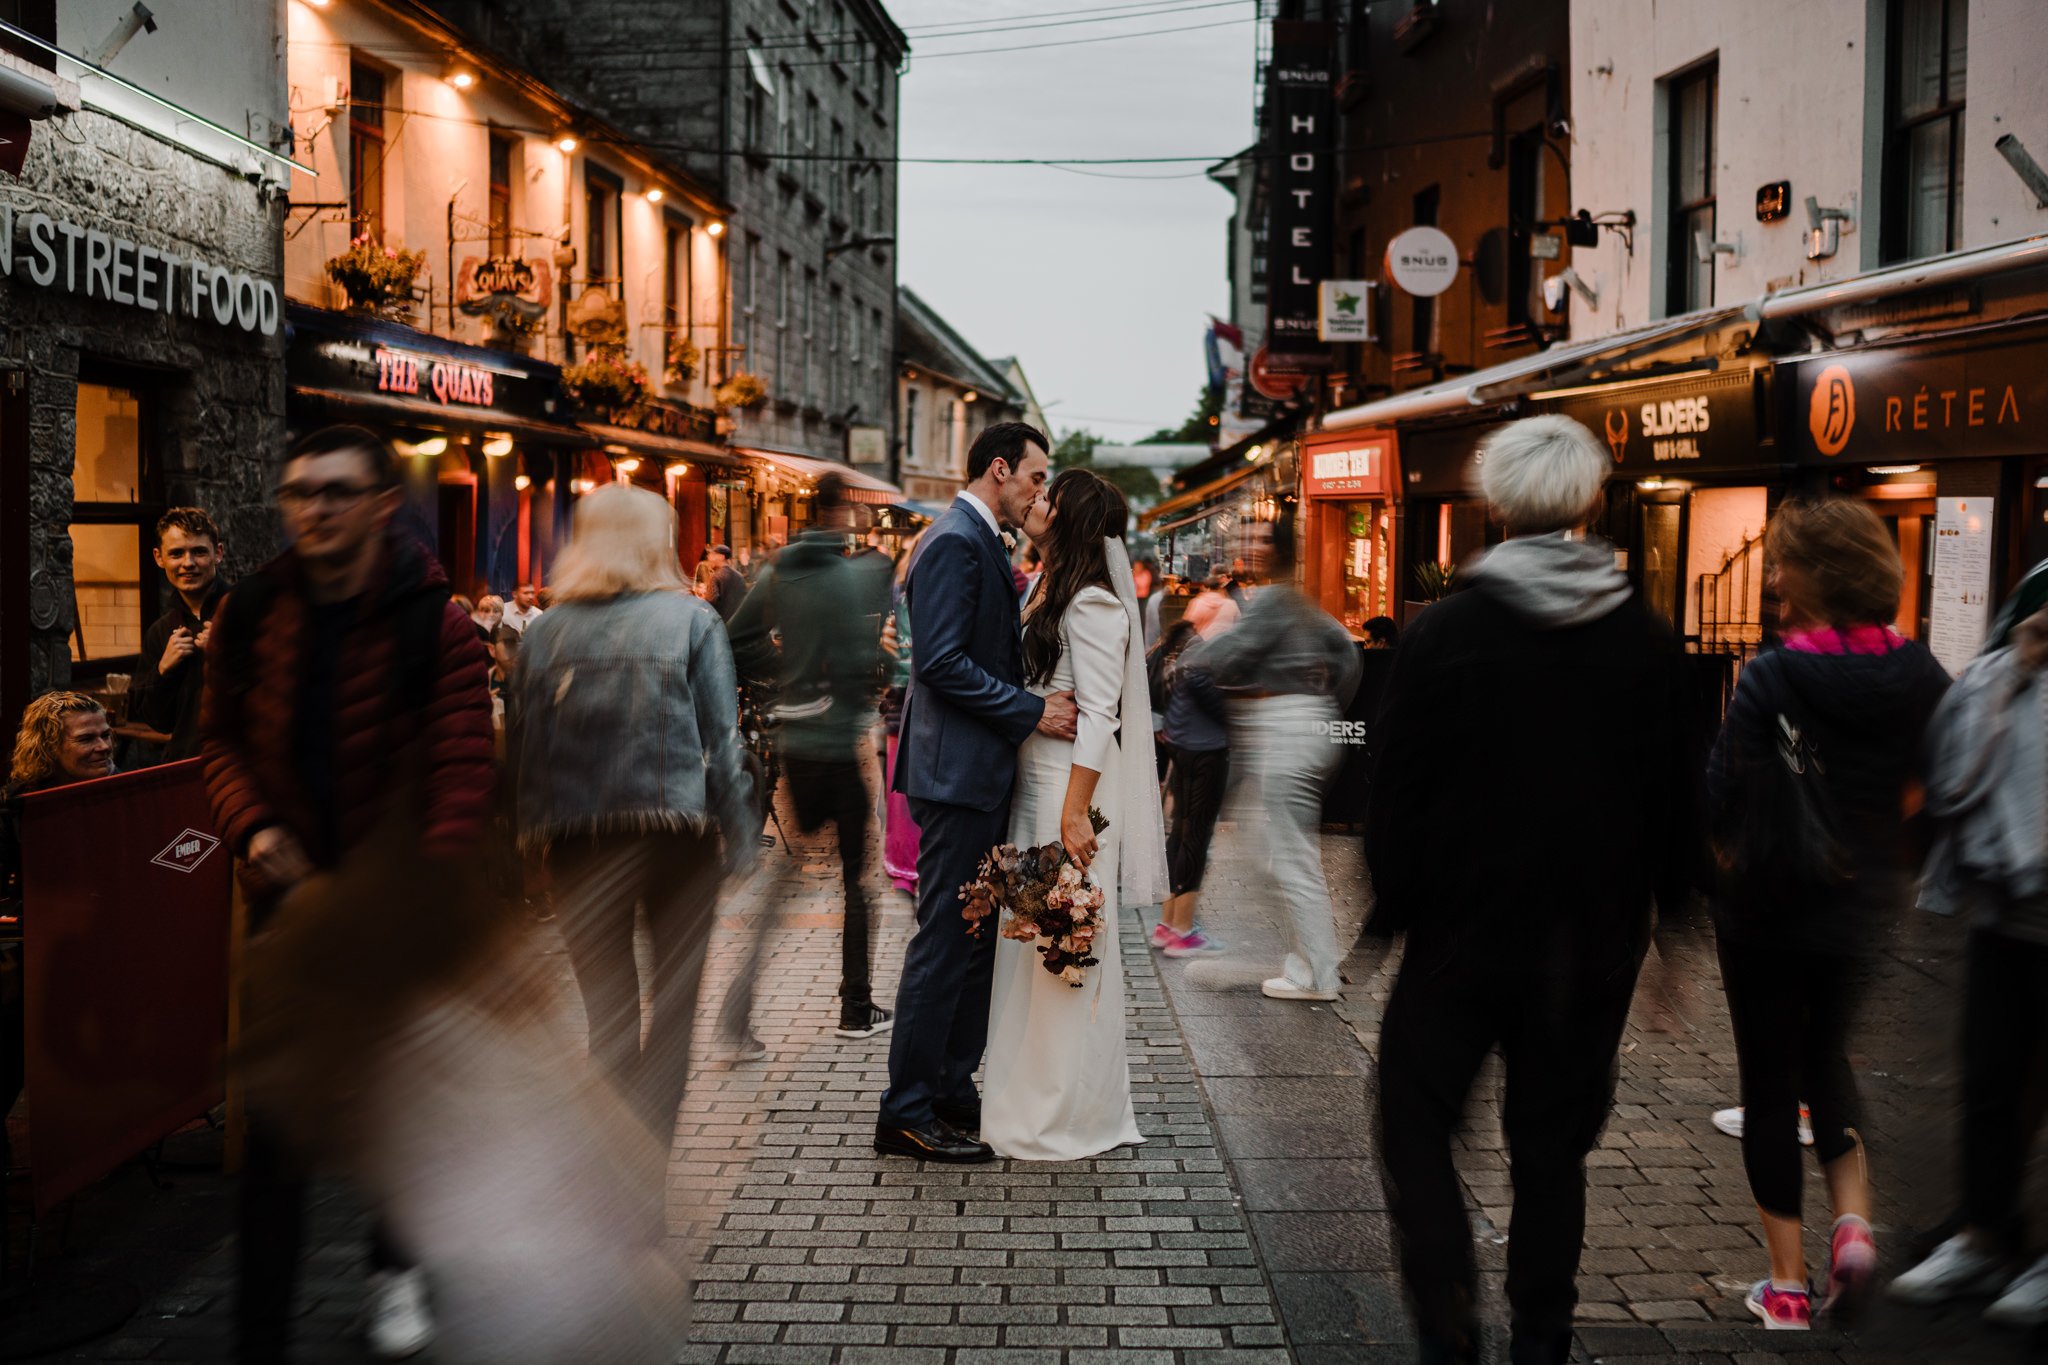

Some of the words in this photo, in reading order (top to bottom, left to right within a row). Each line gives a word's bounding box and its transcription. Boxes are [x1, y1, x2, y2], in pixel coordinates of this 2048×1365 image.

[1291, 115, 1314, 285] HOTEL
[28, 212, 181, 316] STREET
[191, 259, 279, 336] FOOD
[1400, 255, 1449, 267] SNUG
[478, 272, 527, 291] QUAYS
[376, 349, 419, 395] THE
[431, 362, 494, 407] QUAYS
[1641, 395, 1710, 438] SLIDERS
[1312, 721, 1366, 736] IDERS
[175, 840, 200, 858] EMBER
